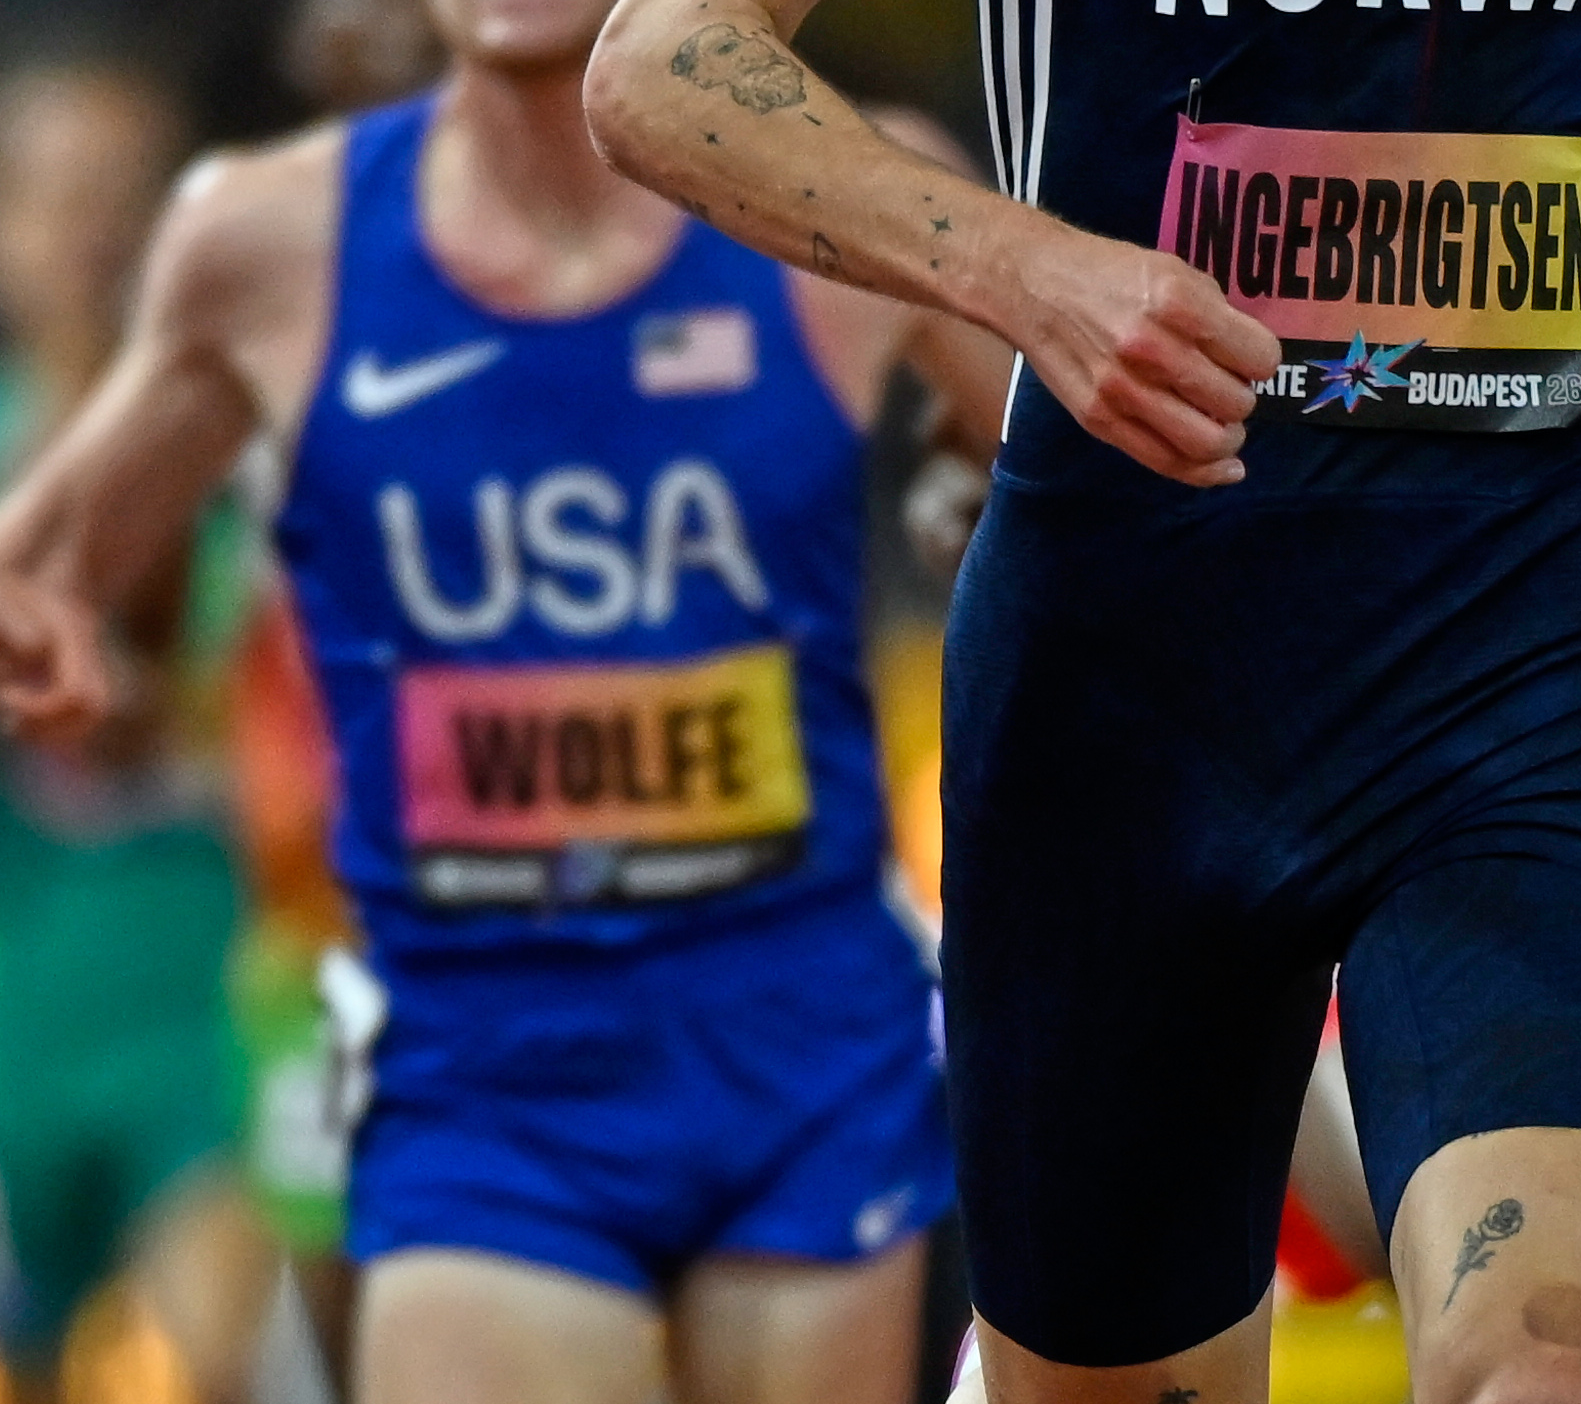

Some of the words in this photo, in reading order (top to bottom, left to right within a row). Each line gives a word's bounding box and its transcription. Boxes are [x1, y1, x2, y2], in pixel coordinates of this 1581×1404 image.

[1408, 371, 1542, 408] BUDAPEST
[376, 457, 770, 642] USA
[452, 692, 756, 811] WOLFE
